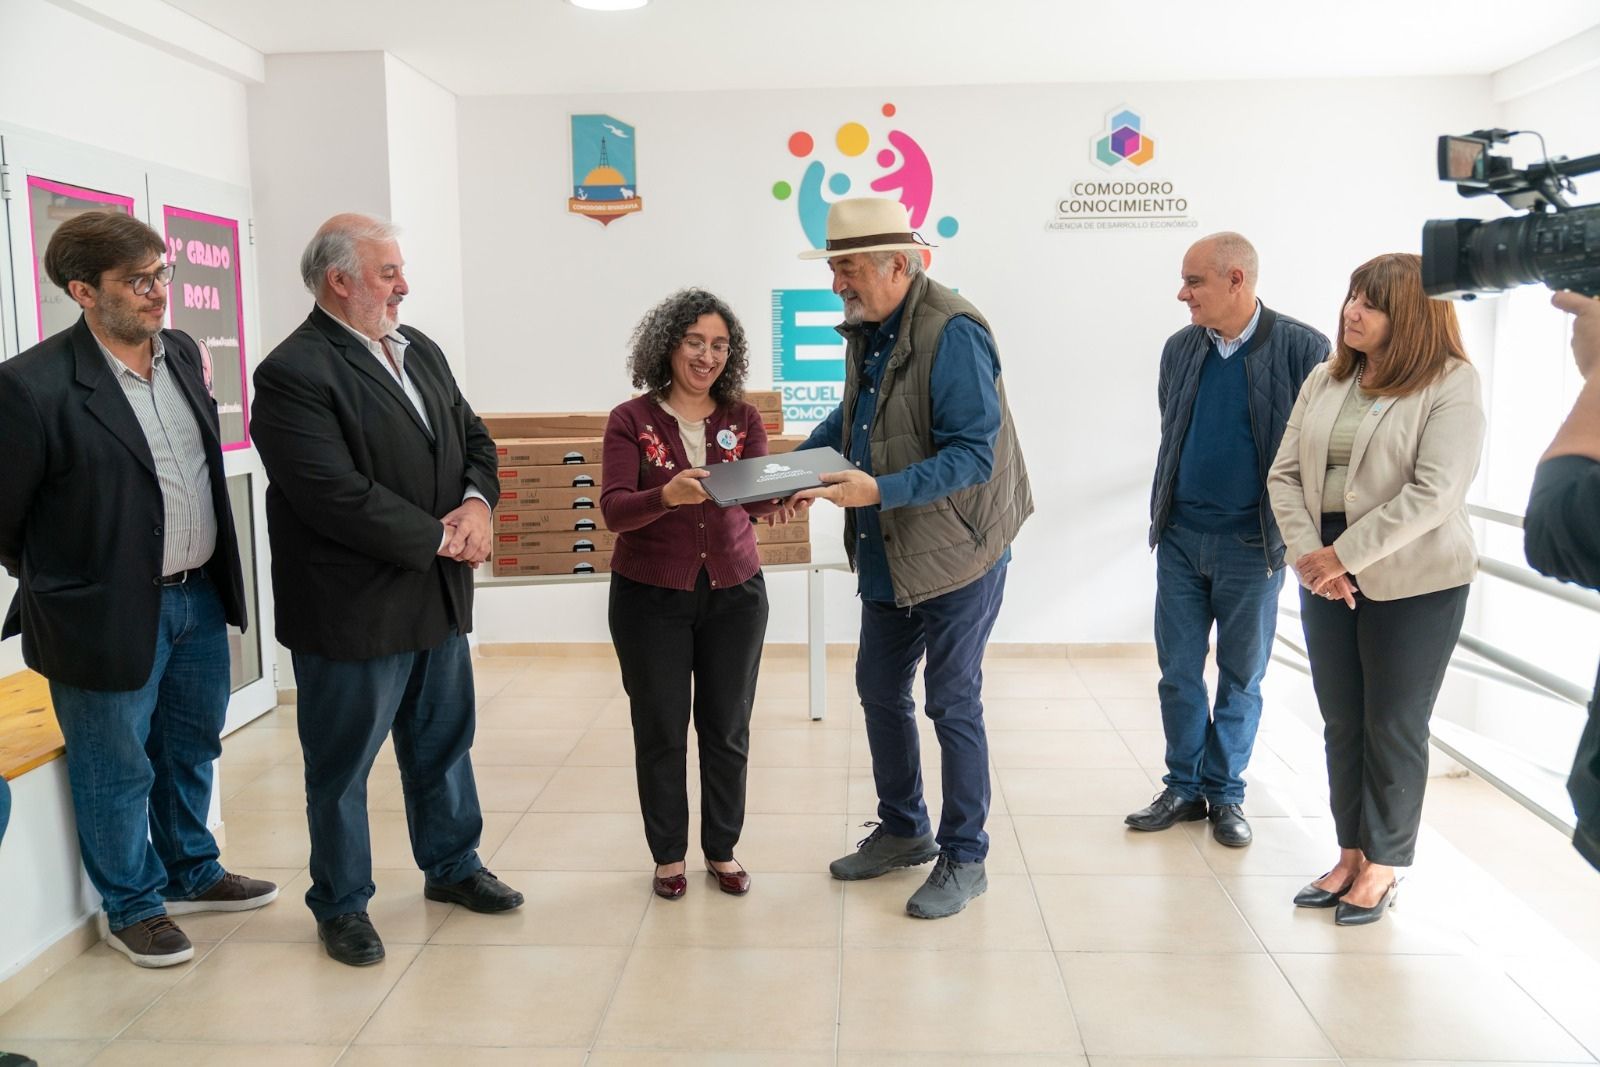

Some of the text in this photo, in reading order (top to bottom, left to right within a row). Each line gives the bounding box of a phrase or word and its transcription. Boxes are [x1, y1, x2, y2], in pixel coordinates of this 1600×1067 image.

[1074, 181, 1174, 196] COMODORO
[1059, 198, 1188, 213] CONOCIMIENTO
[1049, 222, 1082, 230] AGENCIA
[1097, 221, 1148, 229] DESARROLLO
[187, 240, 230, 270] GRADO
[183, 283, 220, 310] ROSA
[772, 386, 841, 401] SCUEL
